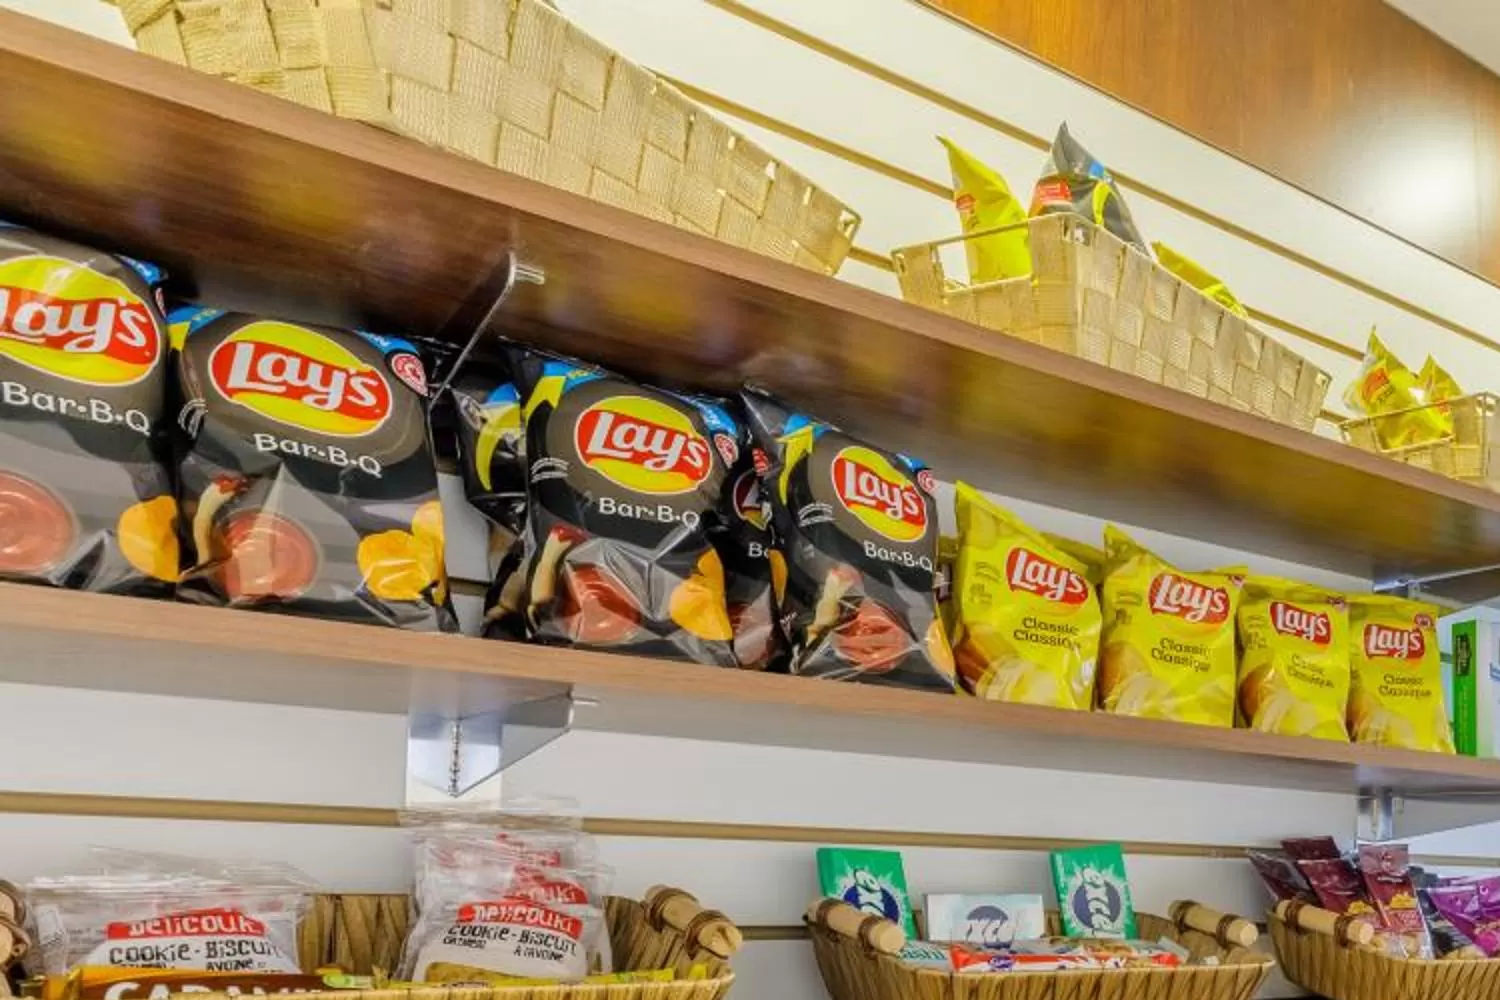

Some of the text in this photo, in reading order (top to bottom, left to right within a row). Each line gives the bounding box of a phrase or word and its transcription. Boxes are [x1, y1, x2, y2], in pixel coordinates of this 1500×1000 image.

[227, 342, 378, 411] Lay's
[585, 412, 706, 472] Lay's
[845, 461, 919, 520] Lay's
[1011, 549, 1084, 601] Lay's
[1152, 575, 1227, 622] Lay's
[1021, 616, 1080, 636] Classic
[1275, 603, 1328, 640] Lay's
[1366, 625, 1421, 659] Lay's
